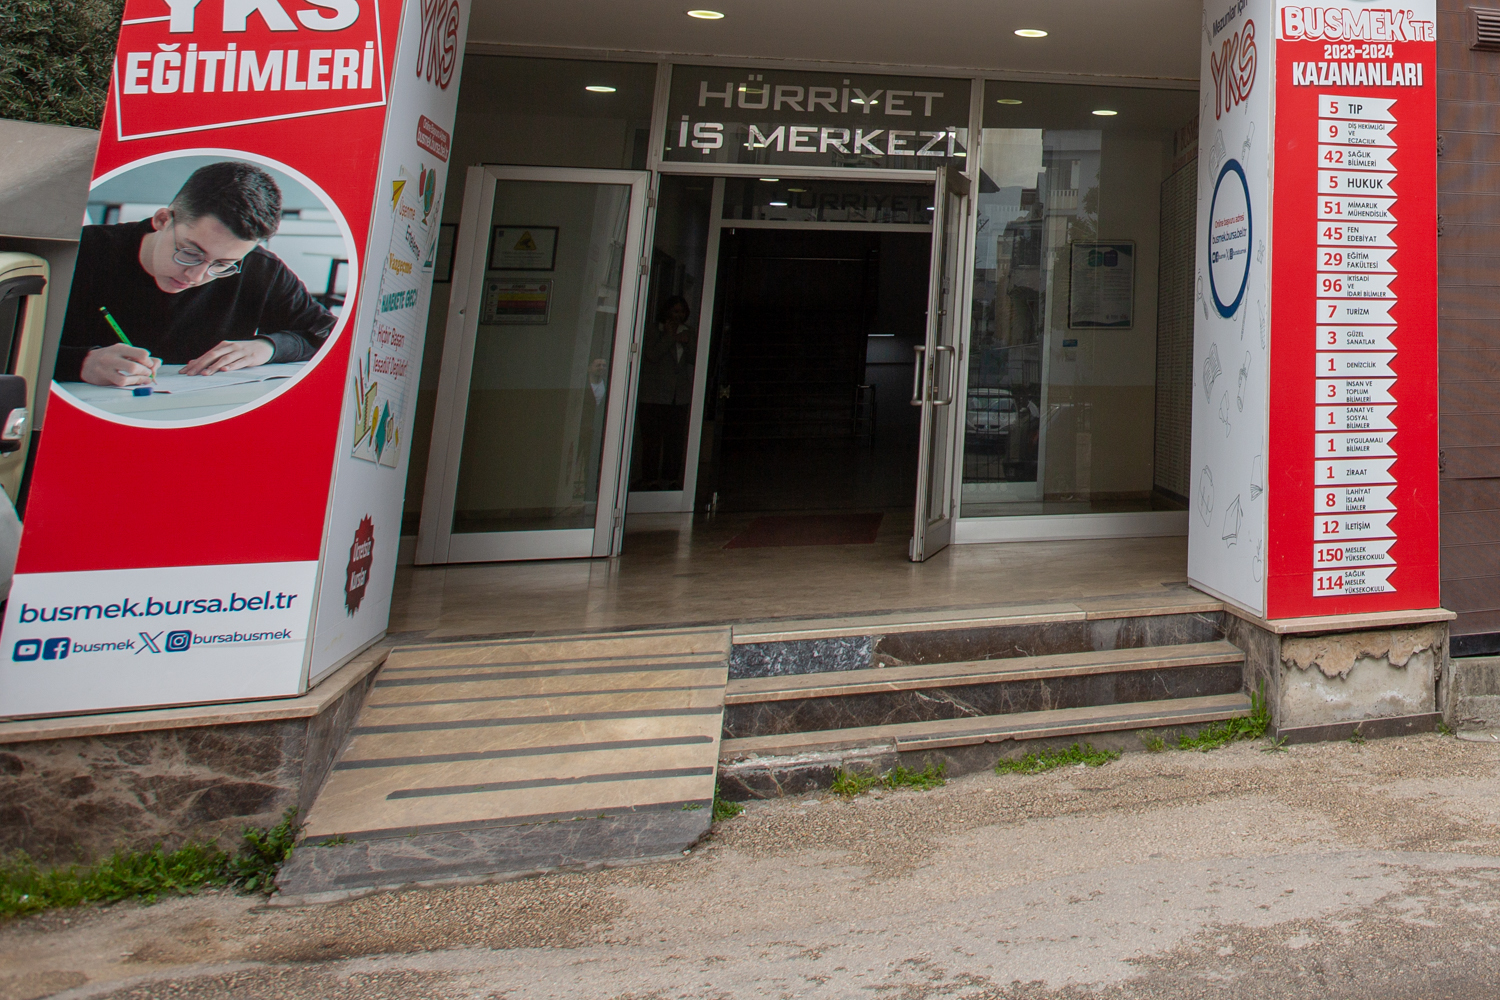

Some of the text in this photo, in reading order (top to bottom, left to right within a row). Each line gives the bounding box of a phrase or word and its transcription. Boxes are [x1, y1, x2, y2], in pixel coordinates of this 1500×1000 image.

[1212, 3, 1237, 38] Mezunlar
[1323, 43, 1394, 59] 2023-2024
[123, 41, 375, 95] EĞİTİMLERİ
[1211, 18, 1257, 120] YKS
[1292, 61, 1423, 87] KAZANANLARI
[698, 74, 944, 117] HÜRRİYET
[1330, 101, 1363, 114] 5 TIP
[679, 115, 956, 158] İŞ MERKEZİ
[1329, 125, 1338, 138] 9
[1324, 150, 1343, 164] 42
[1348, 150, 1371, 158] SAĞLIK
[1348, 159, 1377, 167] BİLİMLERİ
[1329, 176, 1383, 189] 5 HUKUK
[1324, 201, 1343, 214] 51
[1348, 201, 1377, 209] MİMARLIK
[1347, 209, 1387, 217] MÜHENDİSLİK
[1323, 227, 1343, 240] 45
[1347, 234, 1377, 242] EDEBİYAT
[1324, 252, 1343, 266] 29
[1347, 252, 1369, 260] EĞİTİM
[1347, 260, 1379, 268] FAKÜLTESİ
[1323, 278, 1342, 292] 96
[1328, 305, 1369, 318] 7 TURİZM
[1327, 331, 1337, 345] 3
[1328, 358, 1336, 371] 1
[1327, 384, 1336, 397] 3
[1328, 412, 1336, 424] 1
[1328, 438, 1336, 452] 1
[1327, 466, 1367, 479] 1 ZİRAAT
[1326, 493, 1336, 507] 8
[1346, 495, 1364, 503] İSLAMİ
[1323, 520, 1370, 534] 12 İLETİŞİM
[353, 537, 372, 563] Ücretsiz
[1318, 548, 1343, 562] 150
[349, 567, 367, 592] Kurslar
[1317, 575, 1344, 590] 114
[19, 591, 298, 623] busmek.bursa.bel.tr
[73, 638, 136, 654] busmek
[193, 628, 292, 645] bursabusmek
